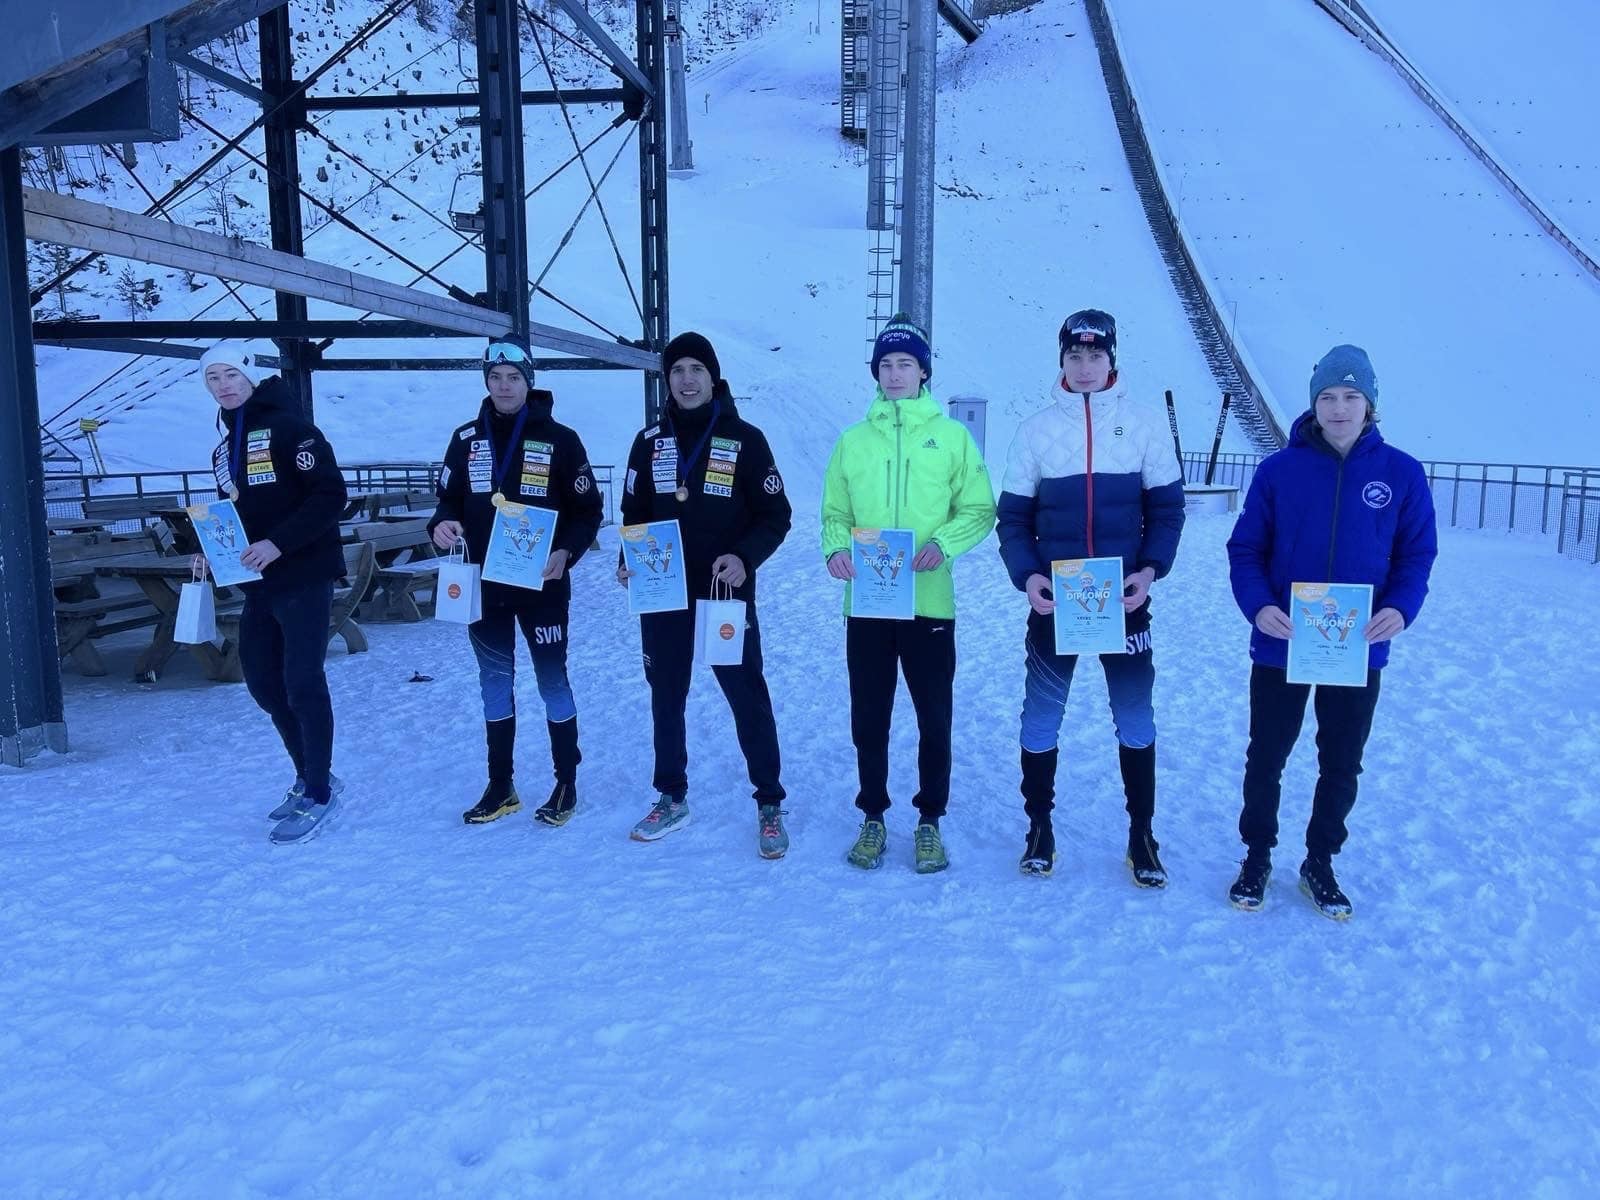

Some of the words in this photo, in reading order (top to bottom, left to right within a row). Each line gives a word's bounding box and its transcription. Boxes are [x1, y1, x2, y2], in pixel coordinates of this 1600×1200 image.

[256, 472, 275, 482] ELES
[528, 486, 546, 496] ELES
[711, 485, 731, 496] ELES
[535, 624, 562, 644] SVN
[1125, 630, 1152, 655] SVN
